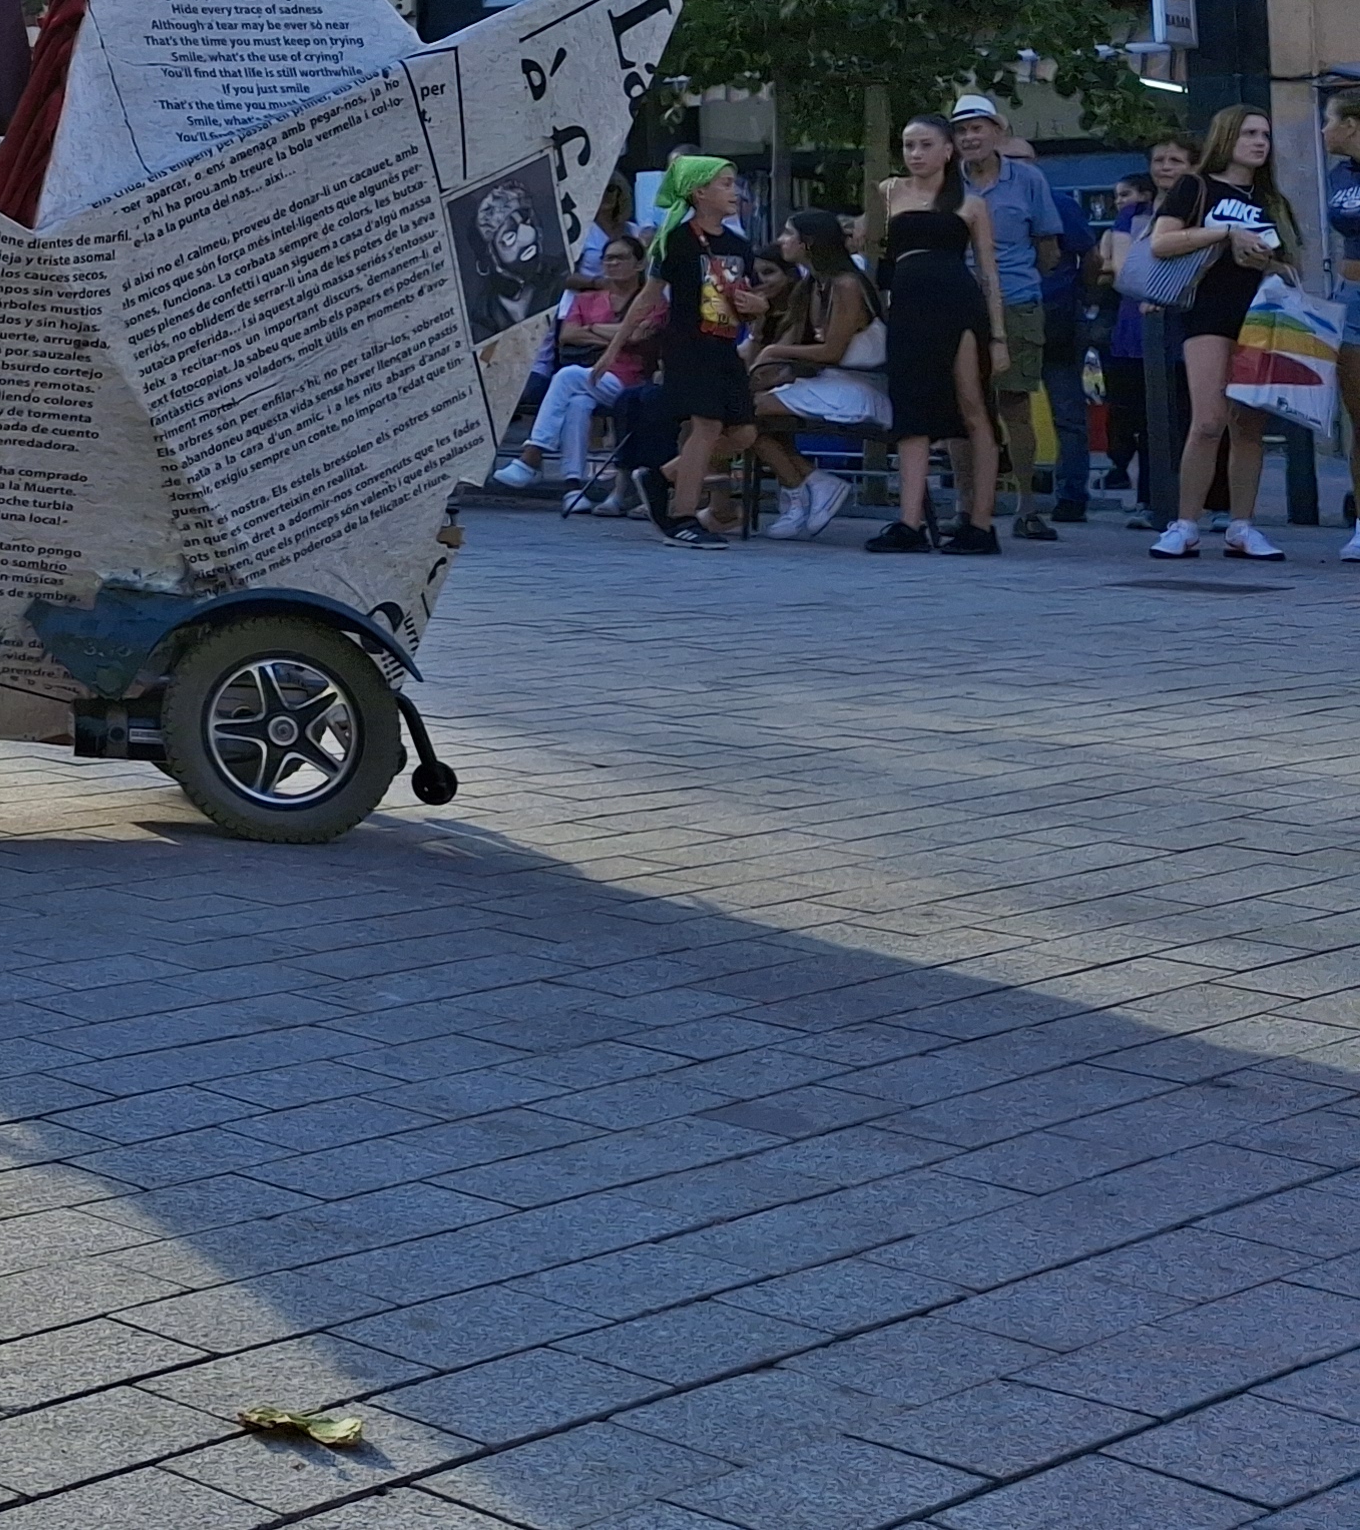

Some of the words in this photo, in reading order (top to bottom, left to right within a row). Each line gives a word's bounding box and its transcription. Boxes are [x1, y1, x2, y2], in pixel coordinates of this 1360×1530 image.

[171, 3, 198, 14] Hide
[201, 6, 232, 16] every
[233, 5, 262, 14] trace
[264, 3, 275, 14] of
[278, 3, 323, 14] sadness
[207, 51, 245, 62] what's
[246, 51, 266, 61] the
[267, 53, 287, 61] use
[290, 50, 301, 61] of
[303, 50, 343, 64] crying?
[221, 83, 230, 95] If
[231, 86, 254, 96] you
[255, 83, 278, 96] just
[279, 82, 309, 93] smile
[420, 80, 447, 107] per
[231, 215, 270, 243] proveu
[272, 208, 286, 220] de
[288, 184, 331, 214] donar-li
[332, 179, 347, 191] un
[395, 146, 418, 162] amb
[1214, 198, 1263, 224] NIKE
[26, 237, 72, 249] dientes
[75, 234, 90, 246] de
[93, 230, 131, 244] marfil.
[32, 286, 52, 296] sin
[56, 287, 110, 299] verdores
[323, 368, 337, 380] no
[340, 357, 357, 374] per
[411, 309, 454, 334] sobretot
[43, 395, 92, 408] colores
[31, 423, 48, 434] de
[50, 427, 99, 439] cuento
[32, 498, 73, 511] turbia
[37, 546, 81, 558] pongo
